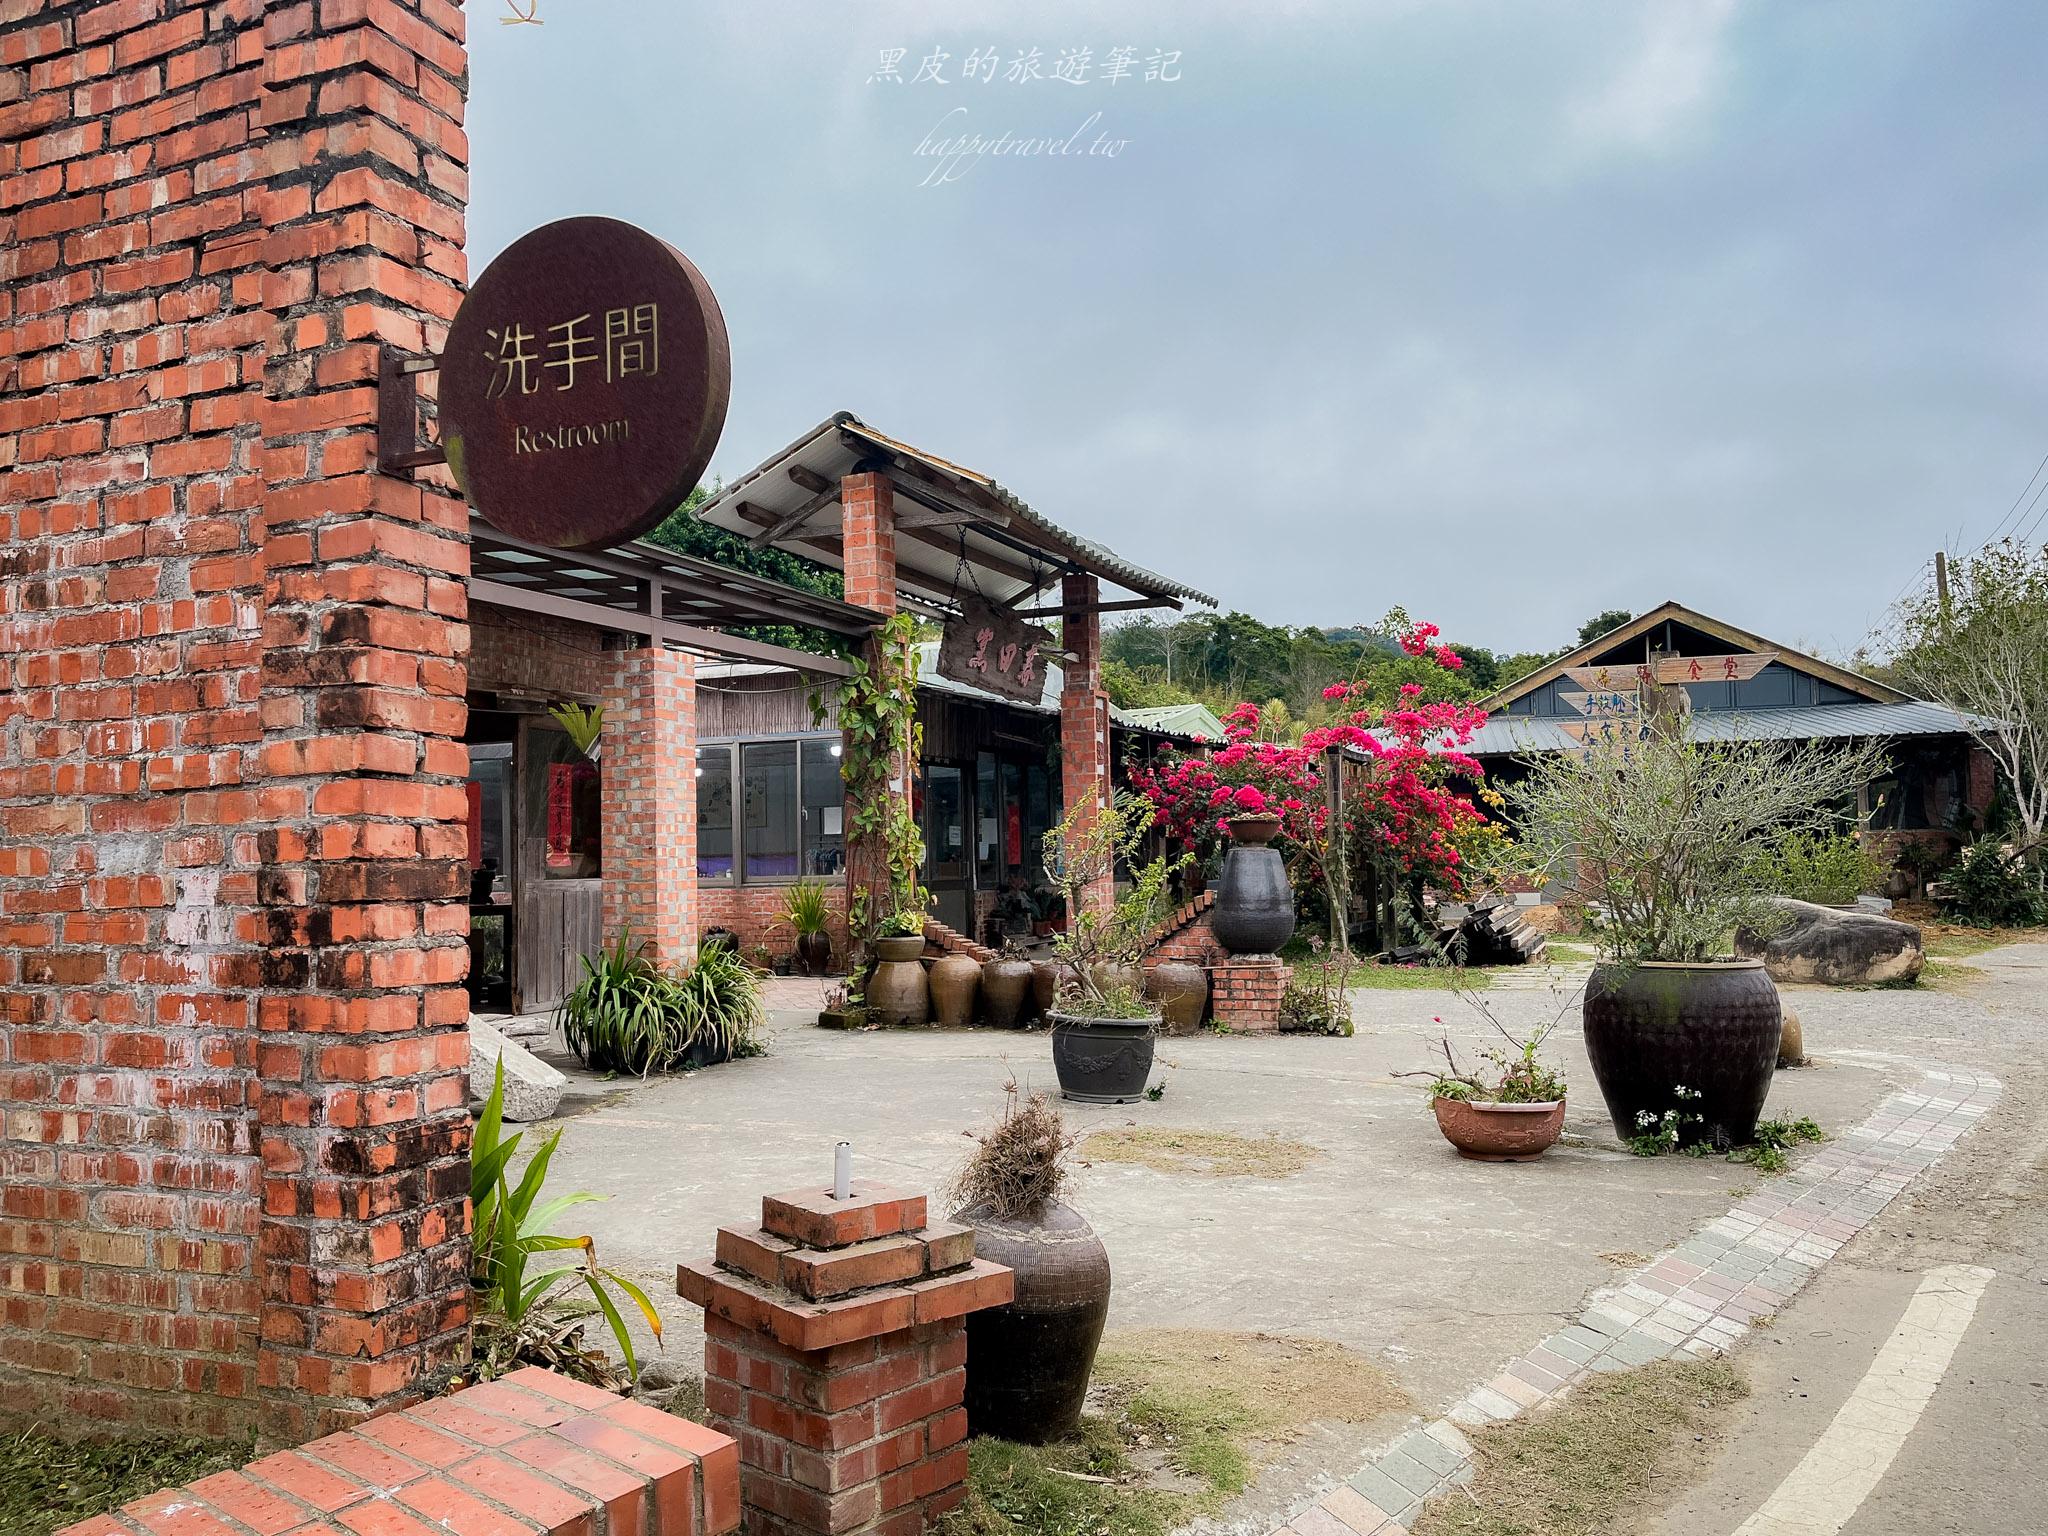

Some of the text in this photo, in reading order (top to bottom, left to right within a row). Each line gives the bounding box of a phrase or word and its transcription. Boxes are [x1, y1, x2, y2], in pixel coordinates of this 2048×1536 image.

[483, 302, 659, 400] 洗手間
[515, 418, 630, 454] Restroom
[1687, 656, 1739, 680] 食堂
